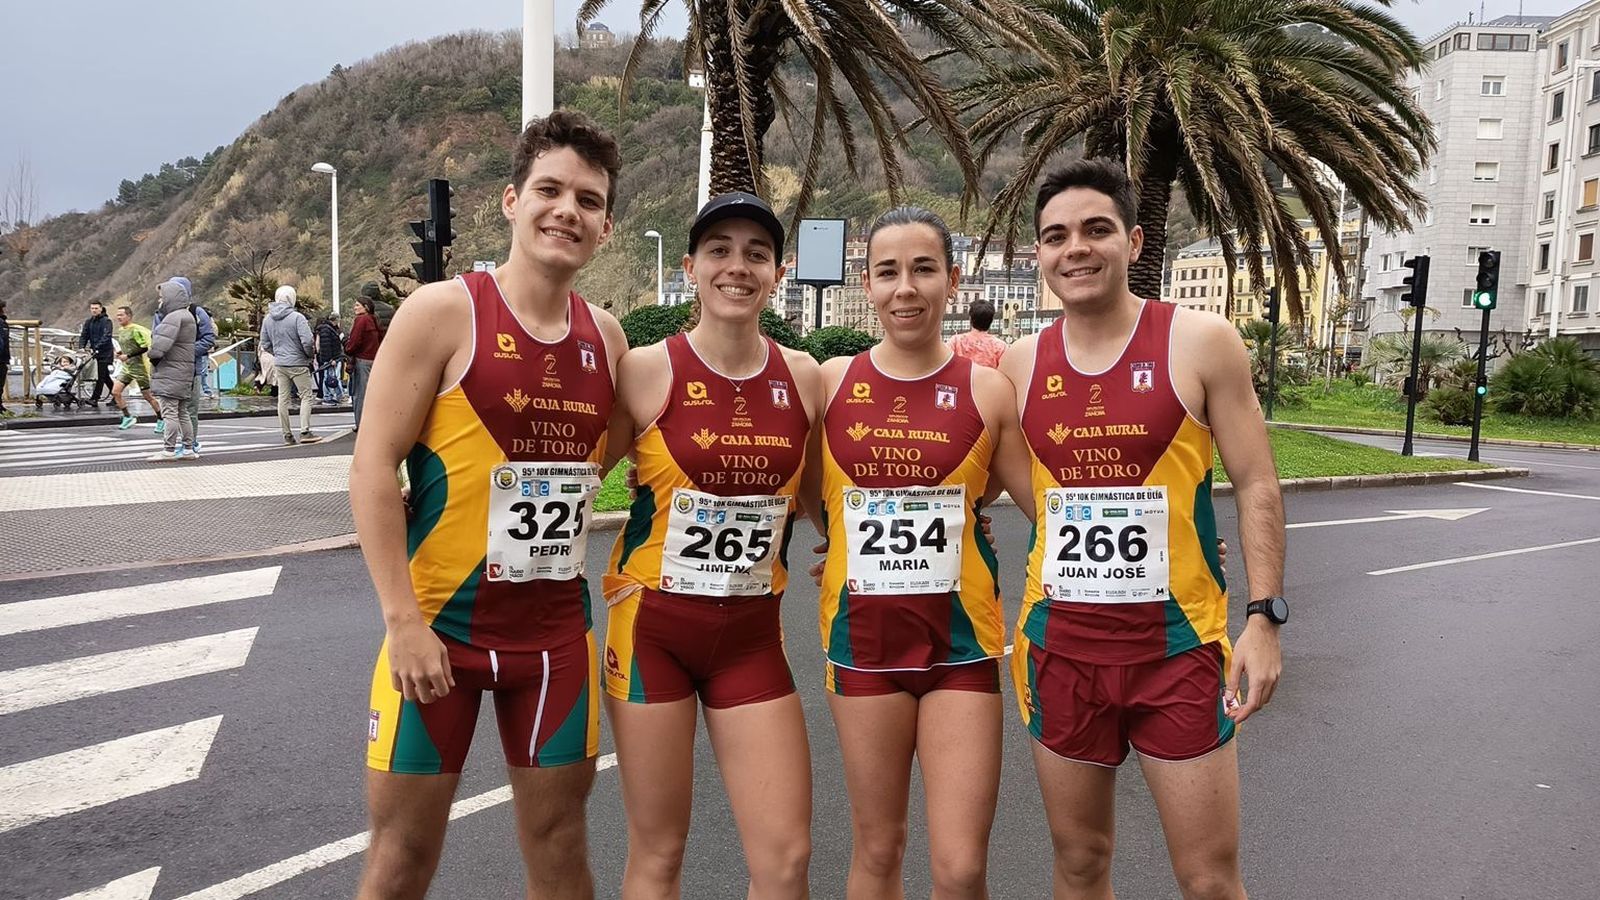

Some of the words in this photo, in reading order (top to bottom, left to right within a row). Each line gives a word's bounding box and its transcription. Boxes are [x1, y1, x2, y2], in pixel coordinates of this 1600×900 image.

[533, 398, 560, 411] CAJA
[563, 401, 598, 415] RURAL
[530, 421, 576, 438] VINO
[873, 428, 905, 439] CAJA
[908, 430, 950, 443] RURAL
[1073, 427, 1103, 438] CAJA
[1105, 424, 1148, 436] RURAL
[512, 439, 537, 453] DE
[541, 440, 588, 457] TORO
[721, 434, 752, 446] CAJA
[754, 435, 792, 448] RURAL
[870, 446, 921, 462] VINO
[1072, 447, 1121, 462] VINO
[720, 455, 768, 469] VINO
[536, 467, 550, 476] 10K
[854, 463, 879, 477] DE
[883, 464, 938, 479] TORO
[1060, 467, 1083, 481] DE
[1086, 464, 1141, 479] TORO
[702, 472, 726, 485] DE
[731, 472, 781, 486] TORO
[522, 480, 549, 497] ate
[1137, 492, 1145, 500] DE
[1066, 504, 1091, 521] ate
[507, 500, 586, 541] 325
[680, 525, 773, 562] 265
[859, 518, 947, 555] 254
[1057, 525, 1148, 563] 266
[529, 545, 572, 557] PEDR
[696, 564, 751, 575] JIMENA
[879, 559, 930, 571] MARIA
[1058, 567, 1098, 578] JUAN
[1103, 564, 1146, 579] JOSÉ
